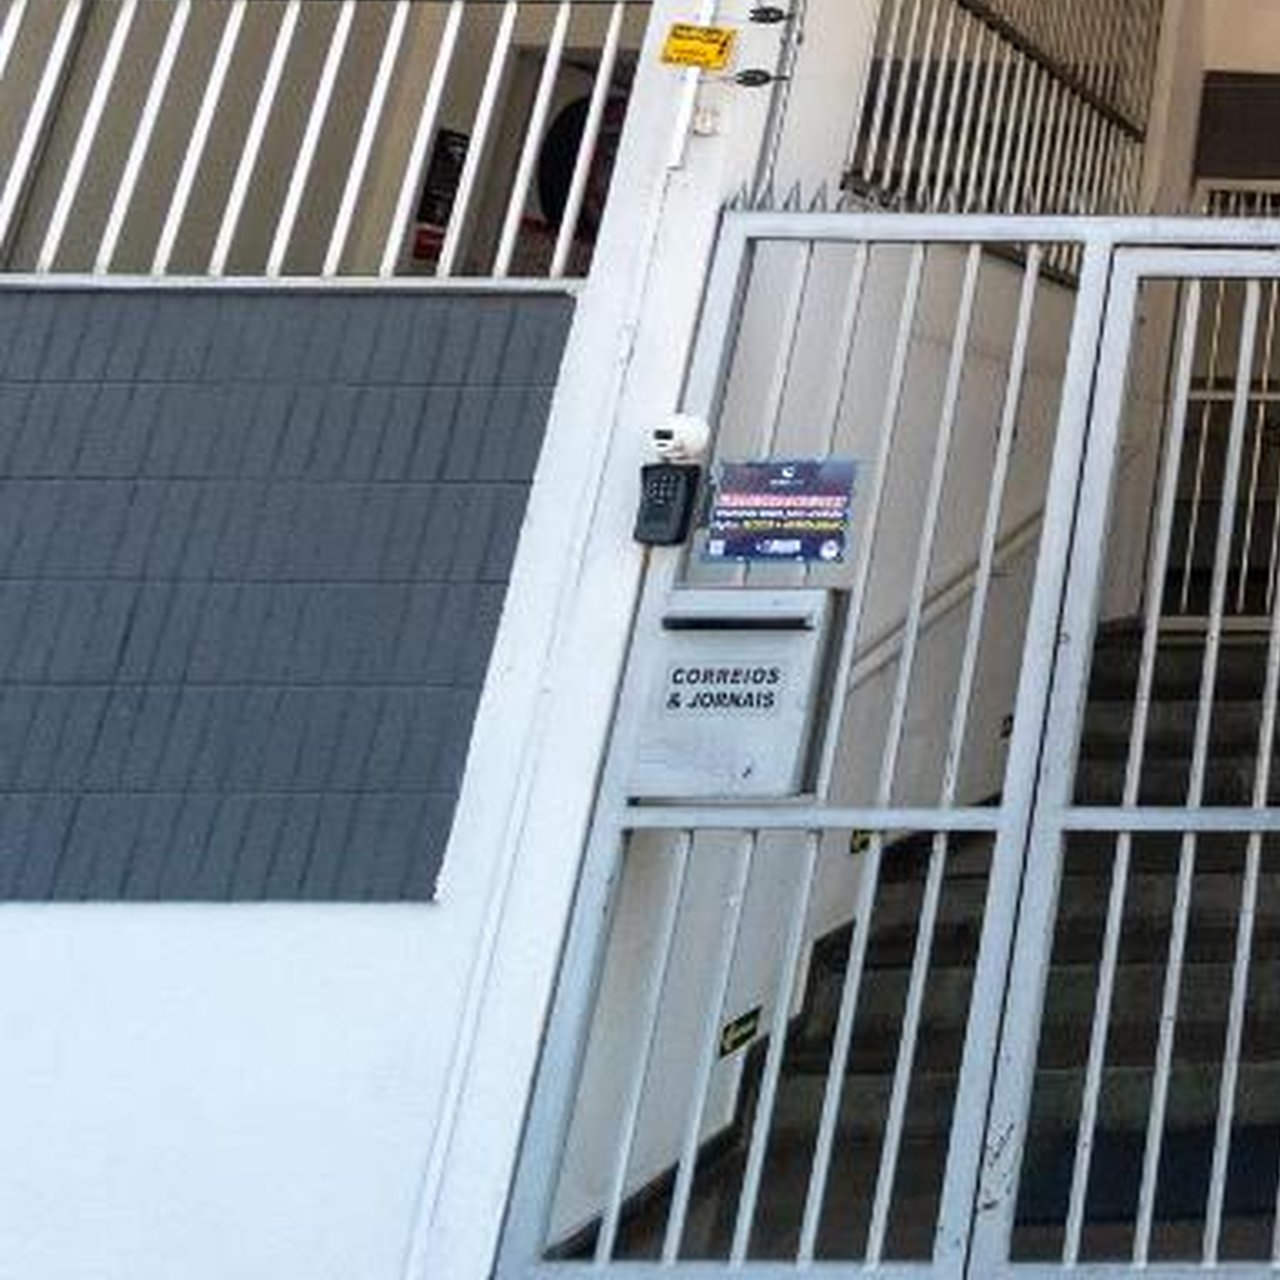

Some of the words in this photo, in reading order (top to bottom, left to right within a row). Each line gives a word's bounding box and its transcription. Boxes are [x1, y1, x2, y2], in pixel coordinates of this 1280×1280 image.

[672, 667, 780, 685] CORREIOS
[666, 691, 681, 709] &
[686, 691, 775, 709] JORNAIS
